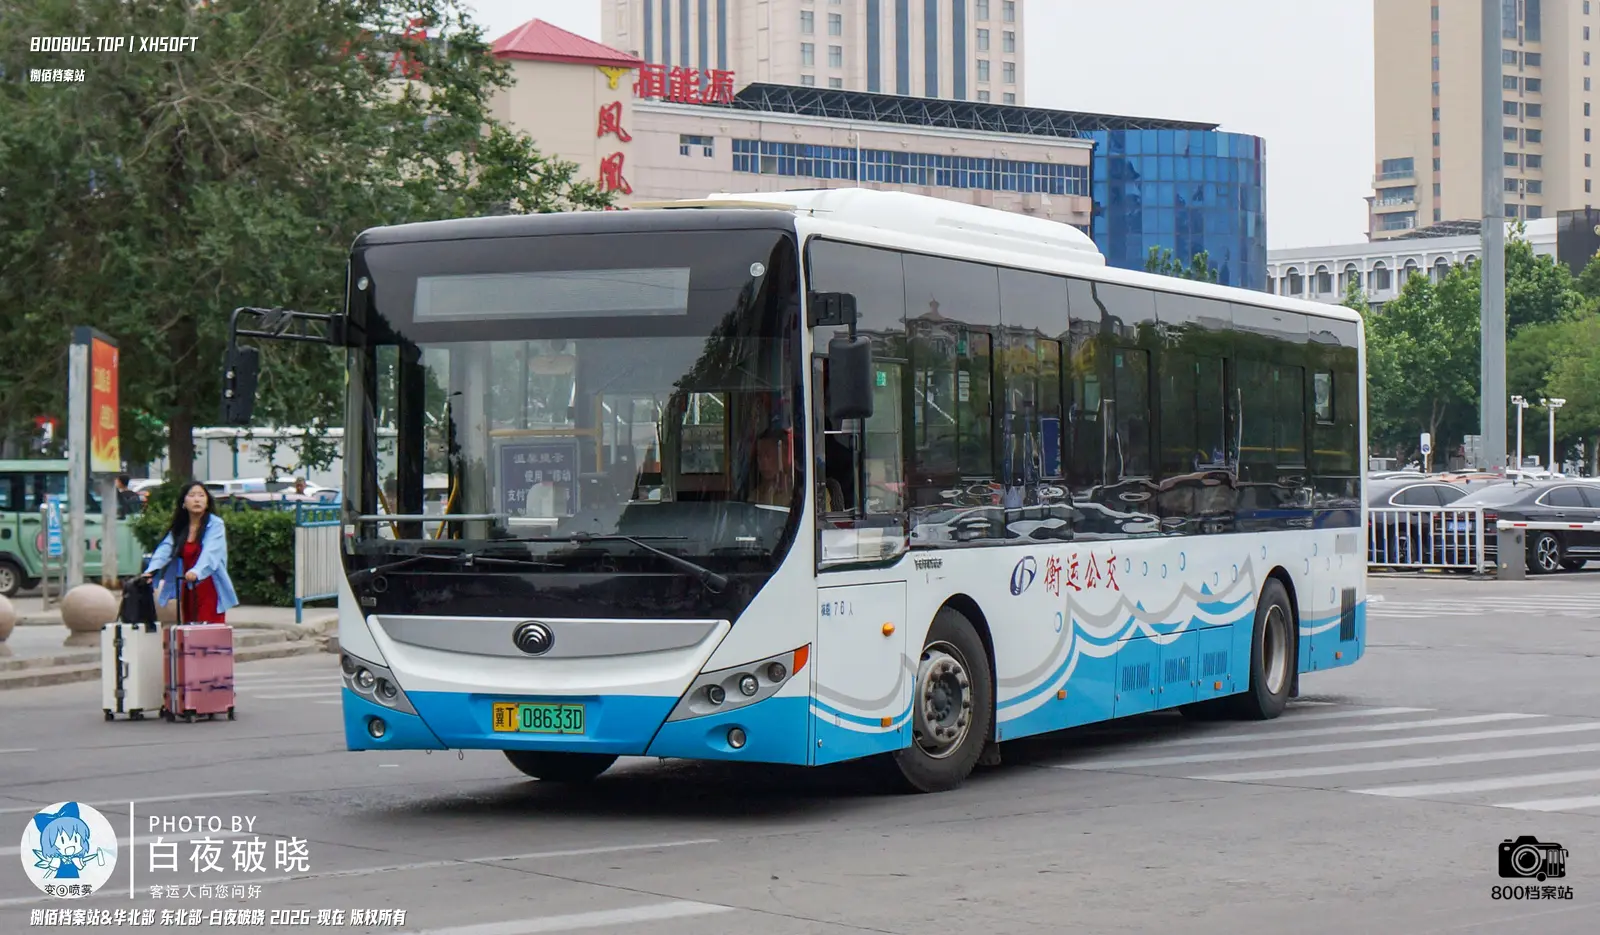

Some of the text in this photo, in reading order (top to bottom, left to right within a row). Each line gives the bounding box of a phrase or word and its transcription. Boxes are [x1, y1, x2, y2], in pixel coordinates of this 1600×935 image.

[632, 64, 736, 104] 恒能源
[1044, 548, 1120, 597] 衡运公交
[495, 707, 583, 730] 冀T 08633D
